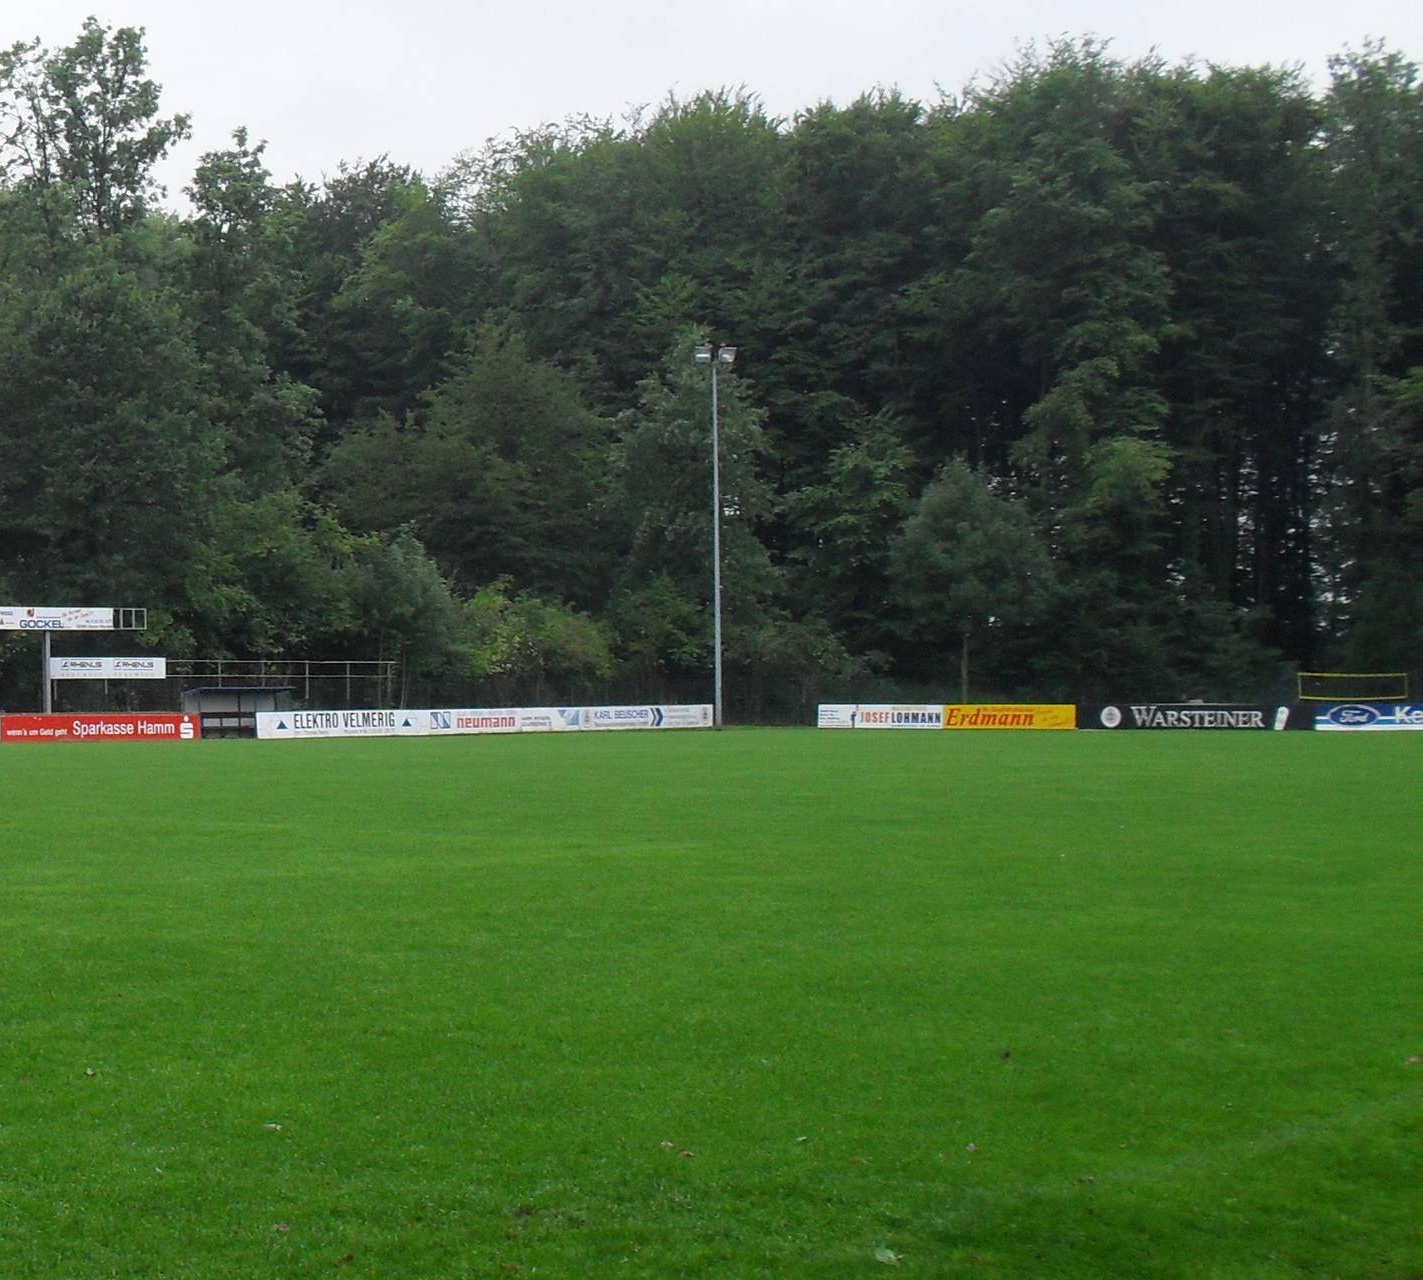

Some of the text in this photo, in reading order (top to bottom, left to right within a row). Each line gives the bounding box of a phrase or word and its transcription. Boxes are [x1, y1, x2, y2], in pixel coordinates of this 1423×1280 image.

[19, 620, 64, 629] GOCKEL
[294, 711, 395, 729] ELEKTRO VELMERIG
[594, 710, 612, 720] KARL
[860, 711, 941, 724] JOSEF LOHMANN
[946, 707, 1034, 726] Erdmann
[1130, 706, 1265, 728] WARSTEINER
[1339, 709, 1370, 723] Ford
[72, 719, 175, 739] Sparkasse Hamm
[457, 716, 515, 729] neumann
[40, 727, 53, 736] Geld
[55, 727, 68, 738] geht
